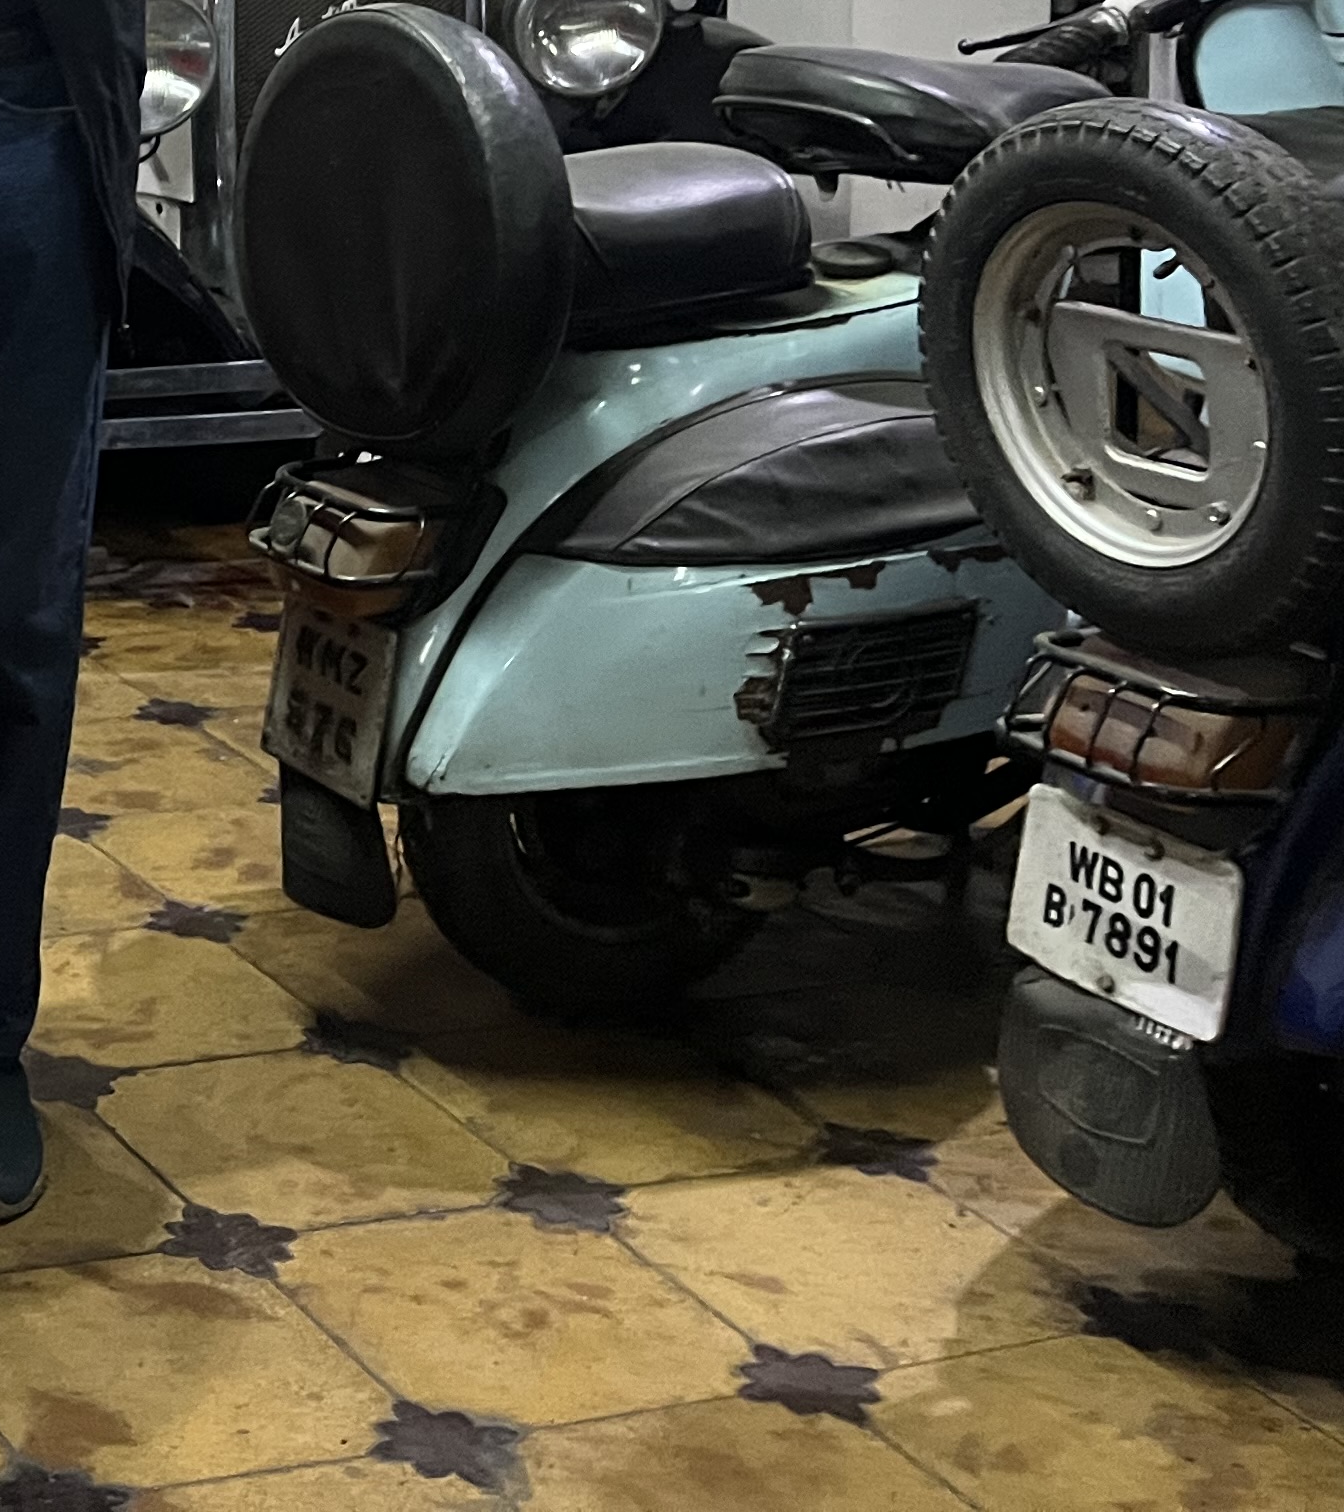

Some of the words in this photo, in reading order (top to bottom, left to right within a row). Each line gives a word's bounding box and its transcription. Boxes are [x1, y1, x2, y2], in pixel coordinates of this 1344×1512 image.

[1069, 840, 1124, 904] WB
[1132, 872, 1176, 929] 01
[1081, 897, 1179, 985] 7891
